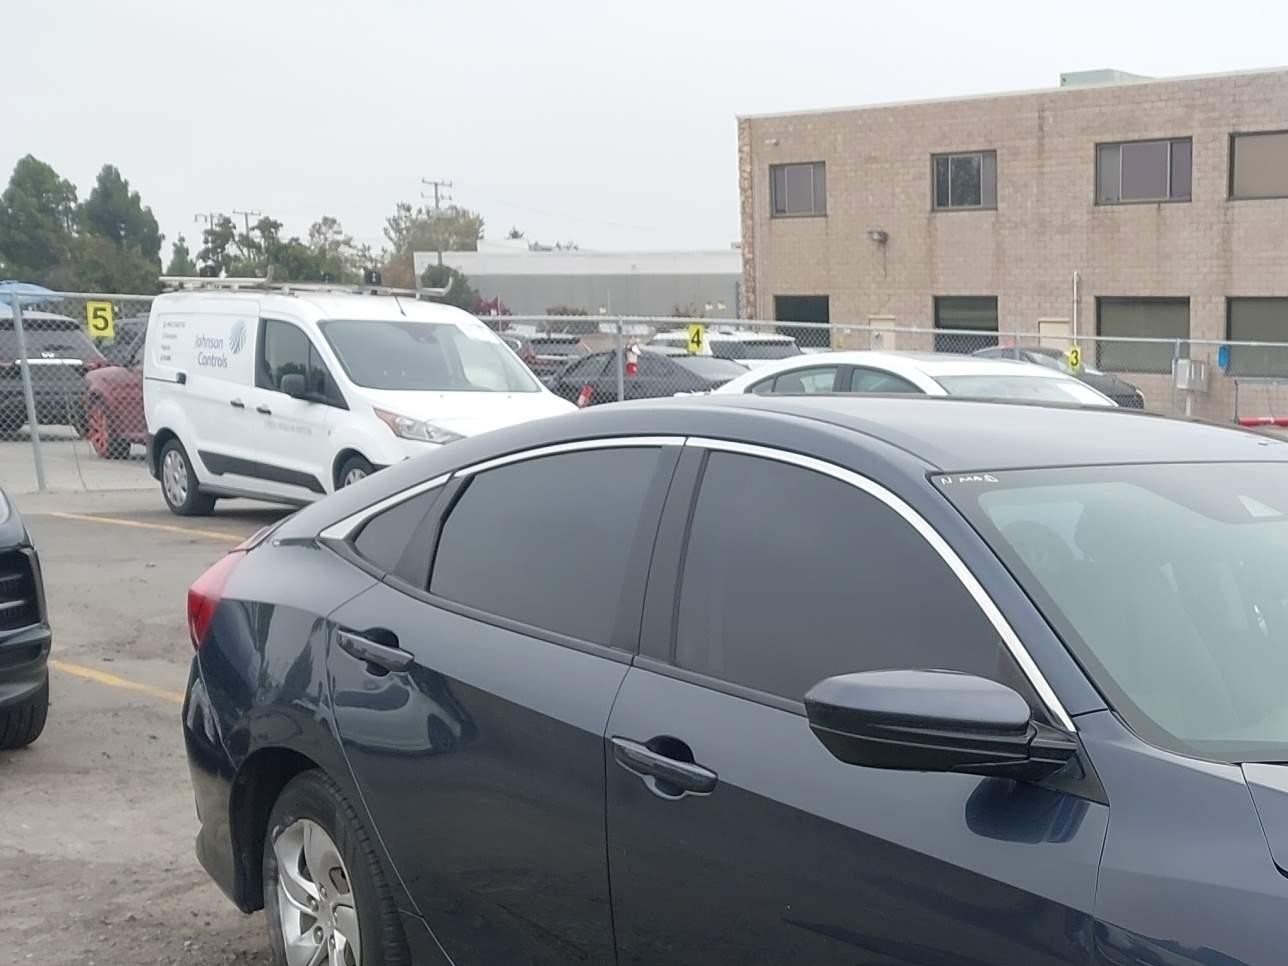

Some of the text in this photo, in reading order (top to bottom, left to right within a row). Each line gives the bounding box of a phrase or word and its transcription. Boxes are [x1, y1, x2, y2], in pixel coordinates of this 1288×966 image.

[91, 306, 109, 331] 5
[195, 332, 224, 350] Johnson
[690, 327, 702, 348] 4
[197, 351, 228, 369] Controls
[1070, 349, 1079, 367] 3
